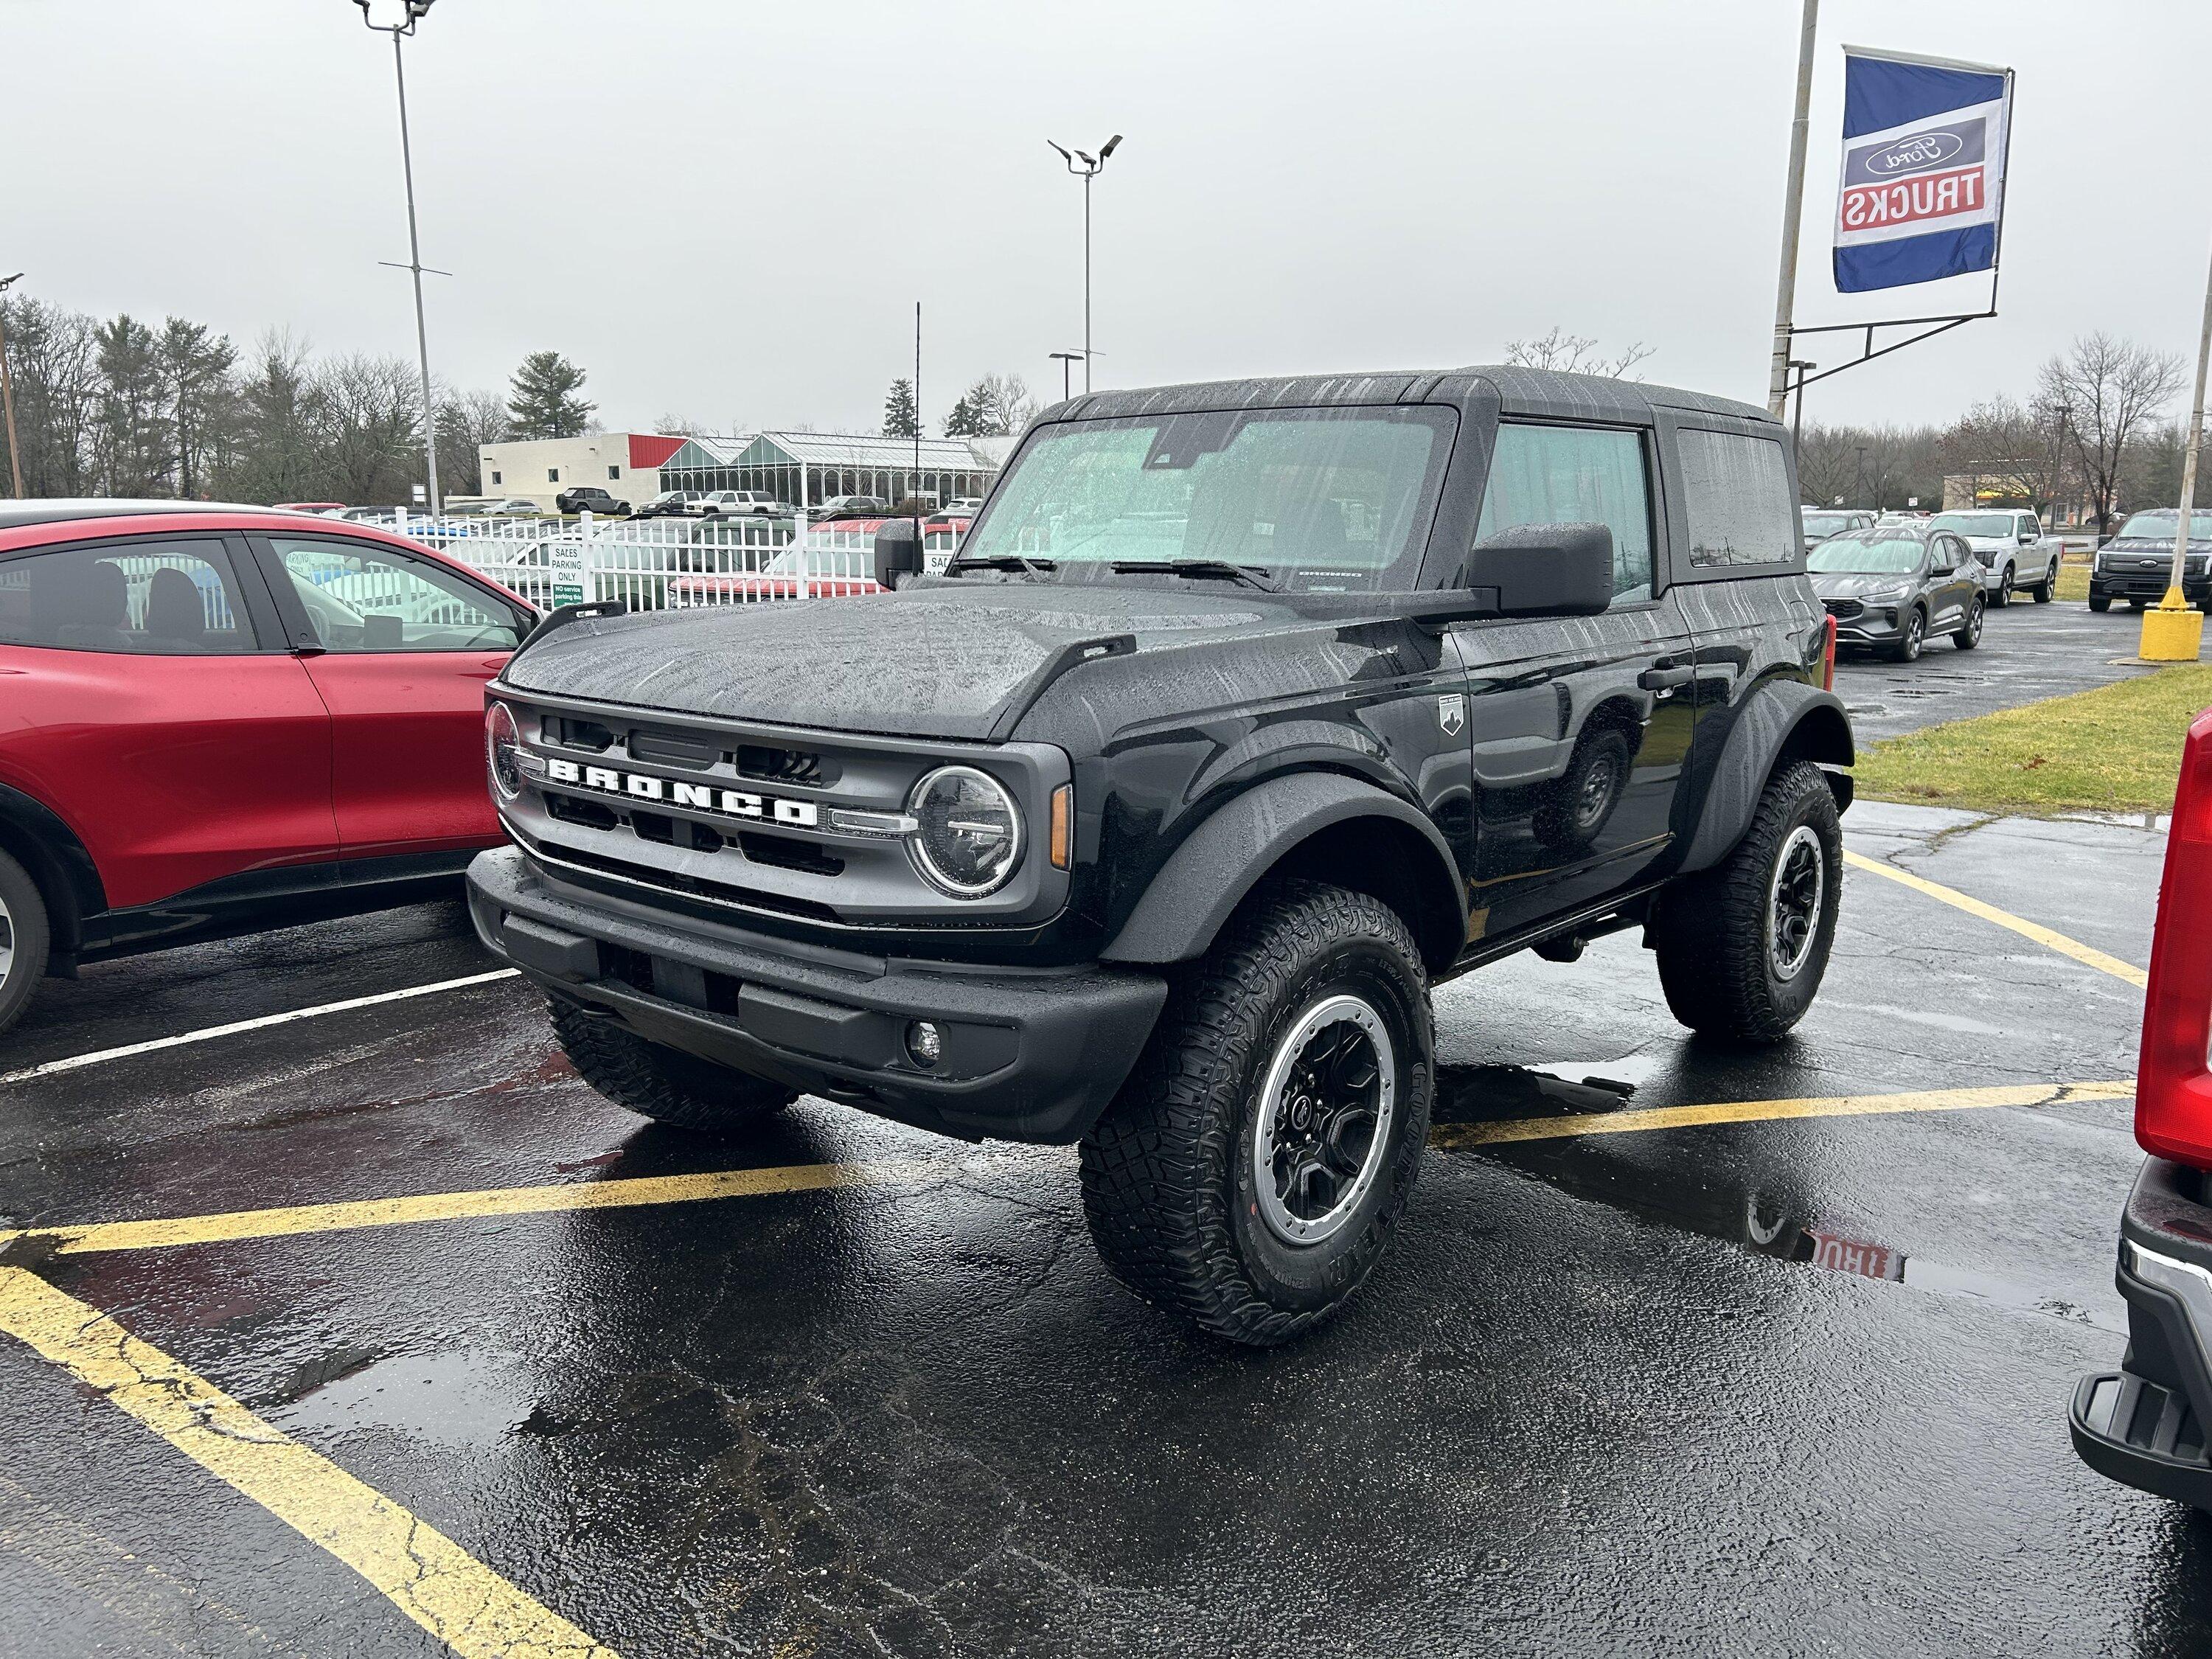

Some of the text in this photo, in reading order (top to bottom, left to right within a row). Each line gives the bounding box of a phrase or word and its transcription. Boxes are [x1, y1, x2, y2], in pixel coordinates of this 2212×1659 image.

[555, 548, 577, 557] SALES
[552, 560, 582, 569] PARKING
[558, 571, 576, 581] ONLY
[549, 759, 818, 827] BRONCO
